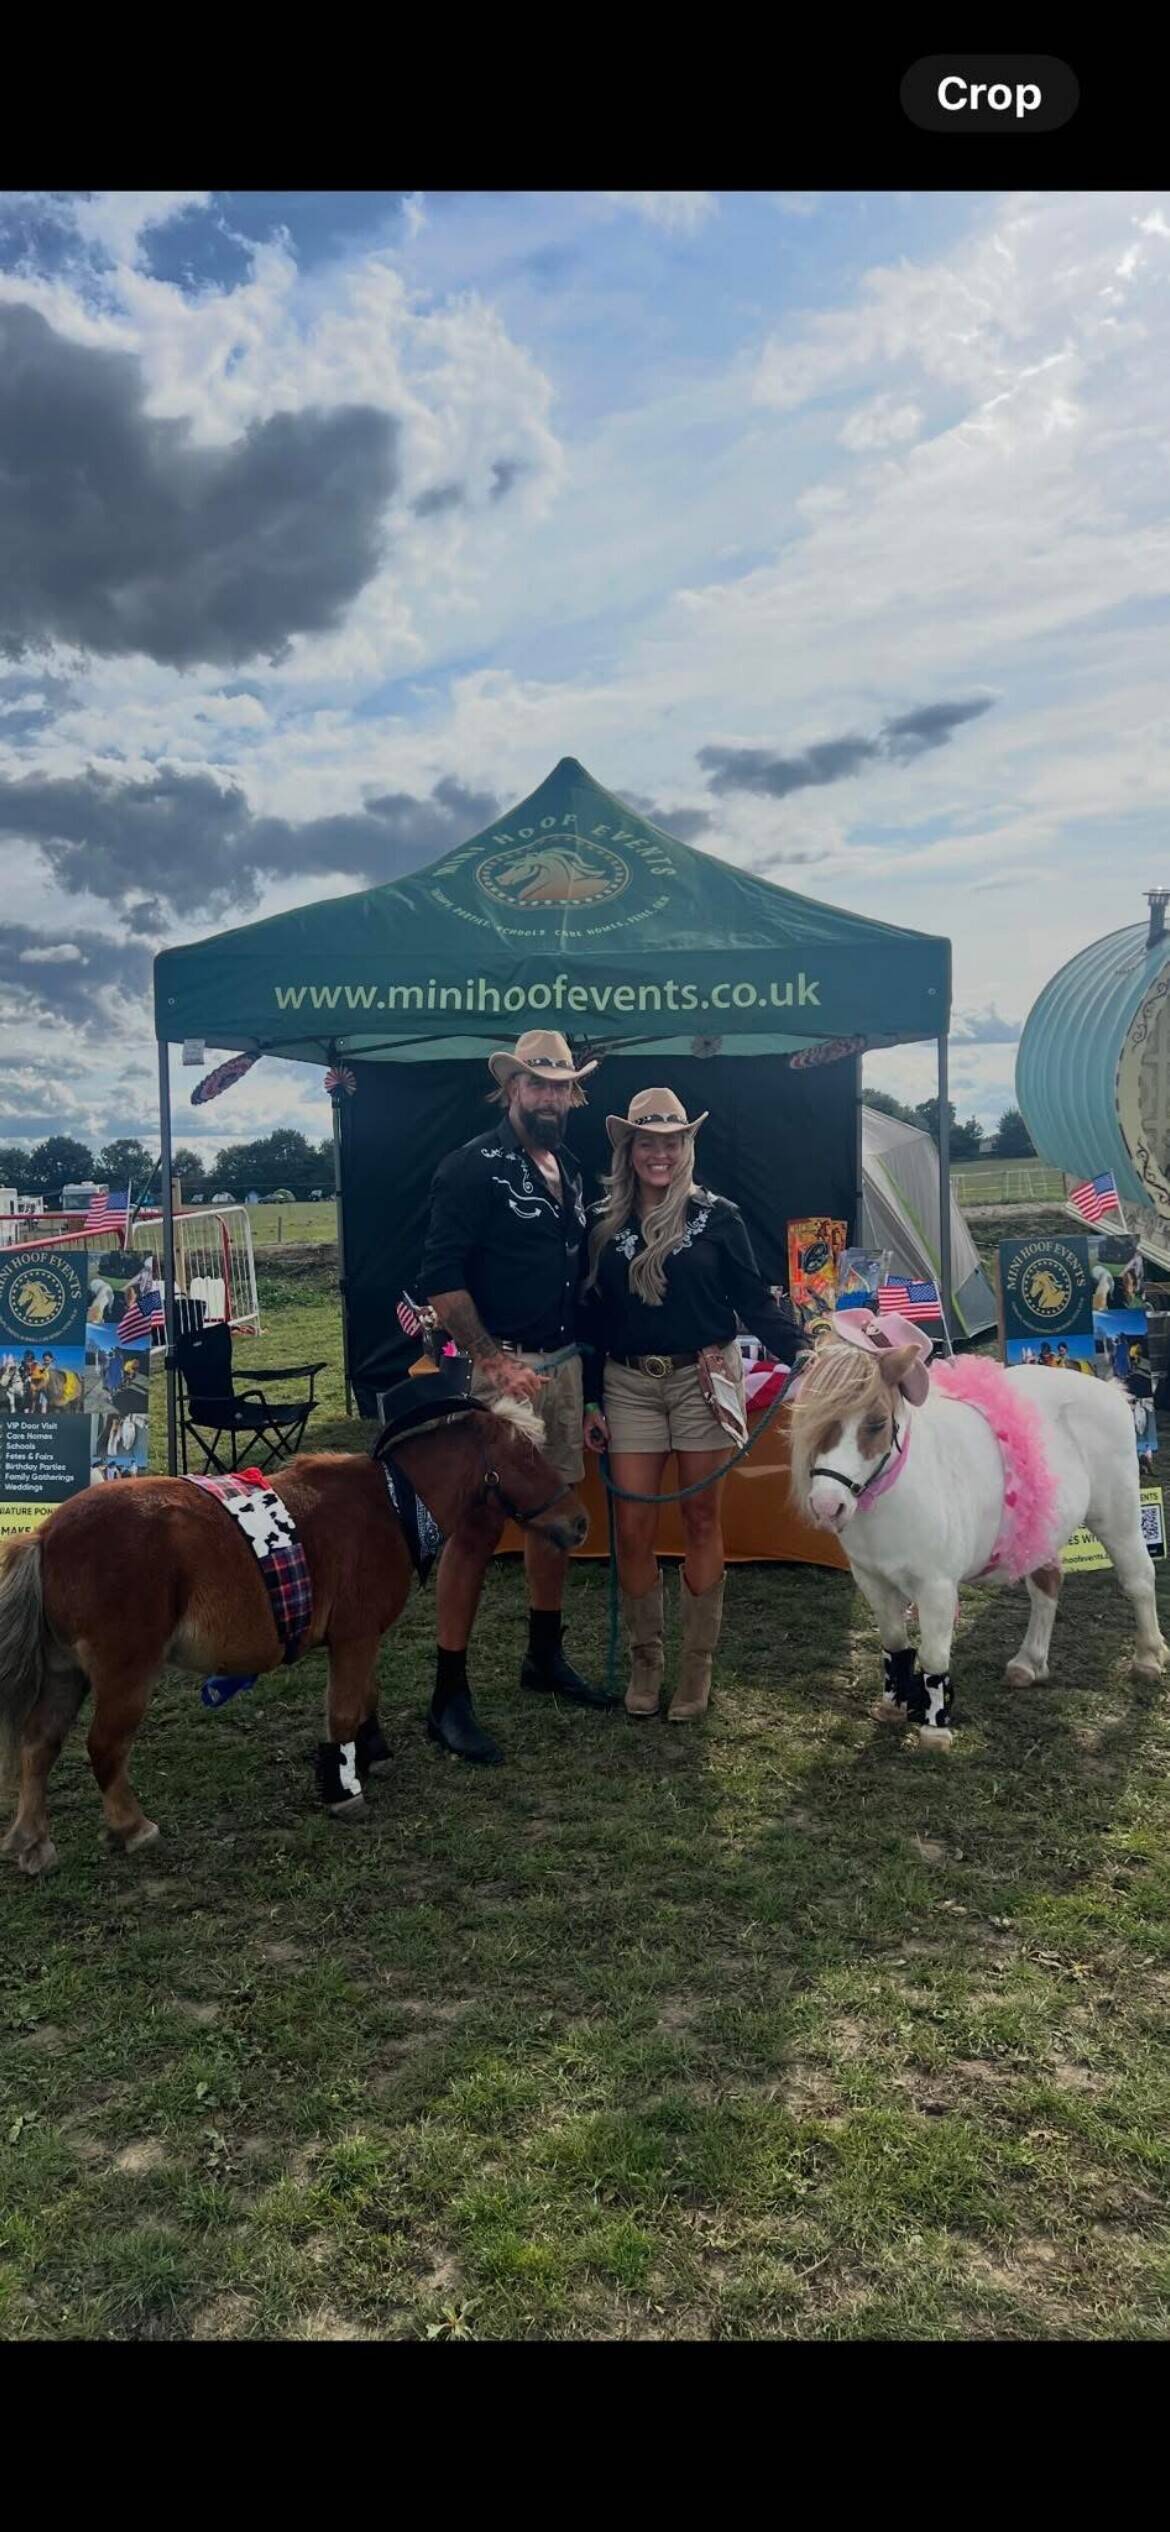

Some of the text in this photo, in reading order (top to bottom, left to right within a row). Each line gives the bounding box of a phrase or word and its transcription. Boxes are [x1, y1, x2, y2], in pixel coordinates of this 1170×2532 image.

[492, 814, 577, 845] HOOF
[591, 823, 677, 878] EVENTS
[274, 972, 822, 1012] www.minihoofevents.co.uk
[1007, 1241, 1087, 1290] MINI HOOF EVENTS
[11, 1252, 48, 1269] HOOF
[48, 1254, 82, 1300] EVENTS
[6, 1422, 58, 1430] VIP Door Visit
[6, 1432, 53, 1440] Care Homes
[6, 1442, 36, 1450] Schools
[5, 1452, 54, 1461] Fetes & Fairs
[5, 1462, 67, 1471] Birthday Parties
[5, 1472, 75, 1483] Family Gatherings
[4, 1483, 44, 1493] Weddings
[1, 1526, 32, 1536] MAKE
